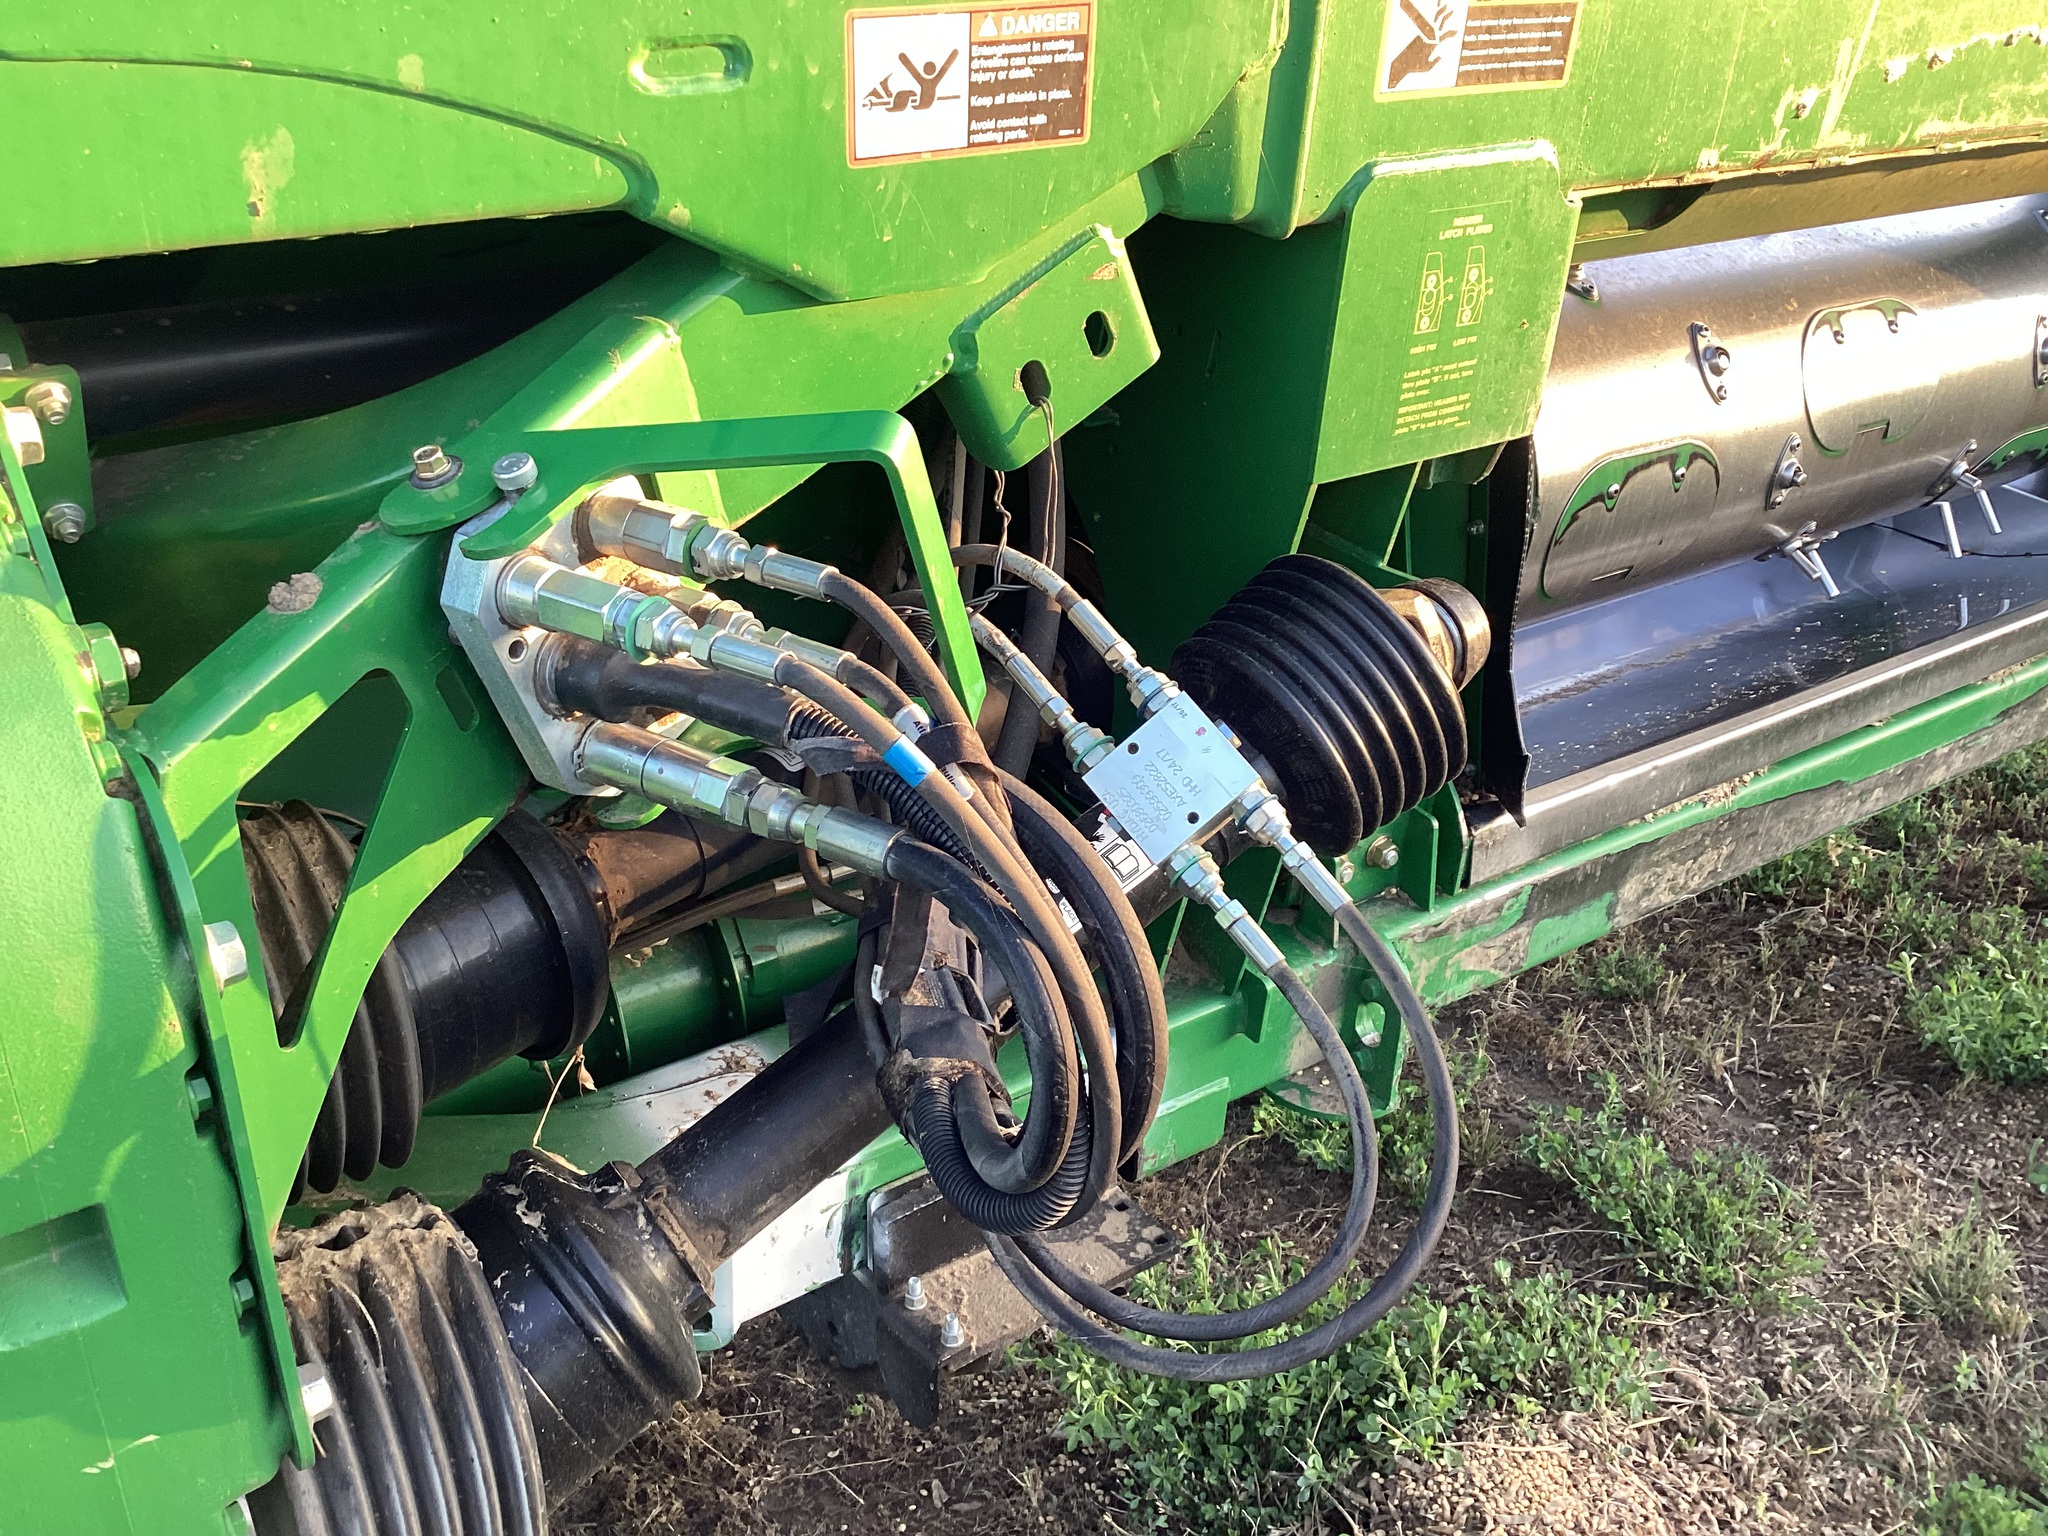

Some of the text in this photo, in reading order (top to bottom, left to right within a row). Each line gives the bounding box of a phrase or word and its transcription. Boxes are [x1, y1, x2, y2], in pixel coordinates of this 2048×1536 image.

[1001, 11, 1080, 36] DANGER
[971, 39, 1074, 57] Entanglement in rotating
[971, 51, 1084, 69] driveline can cause serious
[970, 67, 1034, 84] injury or death.
[971, 89, 1072, 107] Keep all shields in place.
[970, 114, 1047, 130] Avoid contact with
[970, 129, 1028, 143] rotating parts.
[1439, 227, 1464, 240] LATCH
[1155, 747, 1184, 776] 24/17
[1143, 760, 1188, 808] AXE52822
[1100, 787, 1120, 809] USA
[1060, 901, 1078, 923] PLACE
